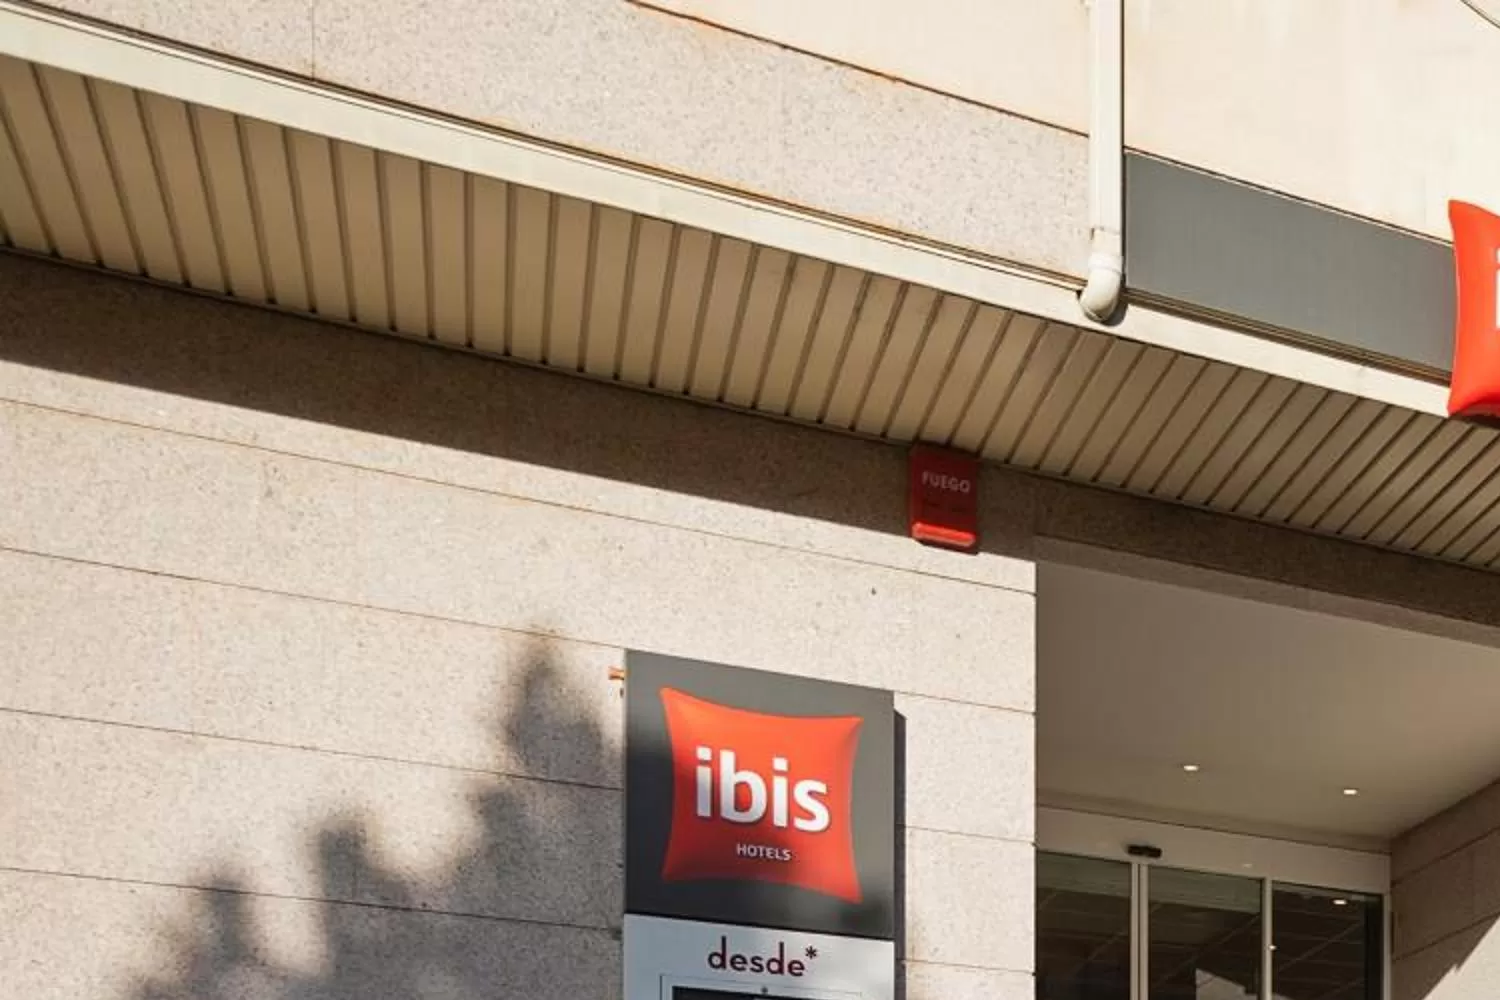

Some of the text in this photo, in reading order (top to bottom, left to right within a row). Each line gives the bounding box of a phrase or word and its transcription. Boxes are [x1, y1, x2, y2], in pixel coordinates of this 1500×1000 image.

[922, 470, 971, 493] FUEGO
[696, 746, 831, 832] ibis
[736, 843, 792, 861] HOTELS
